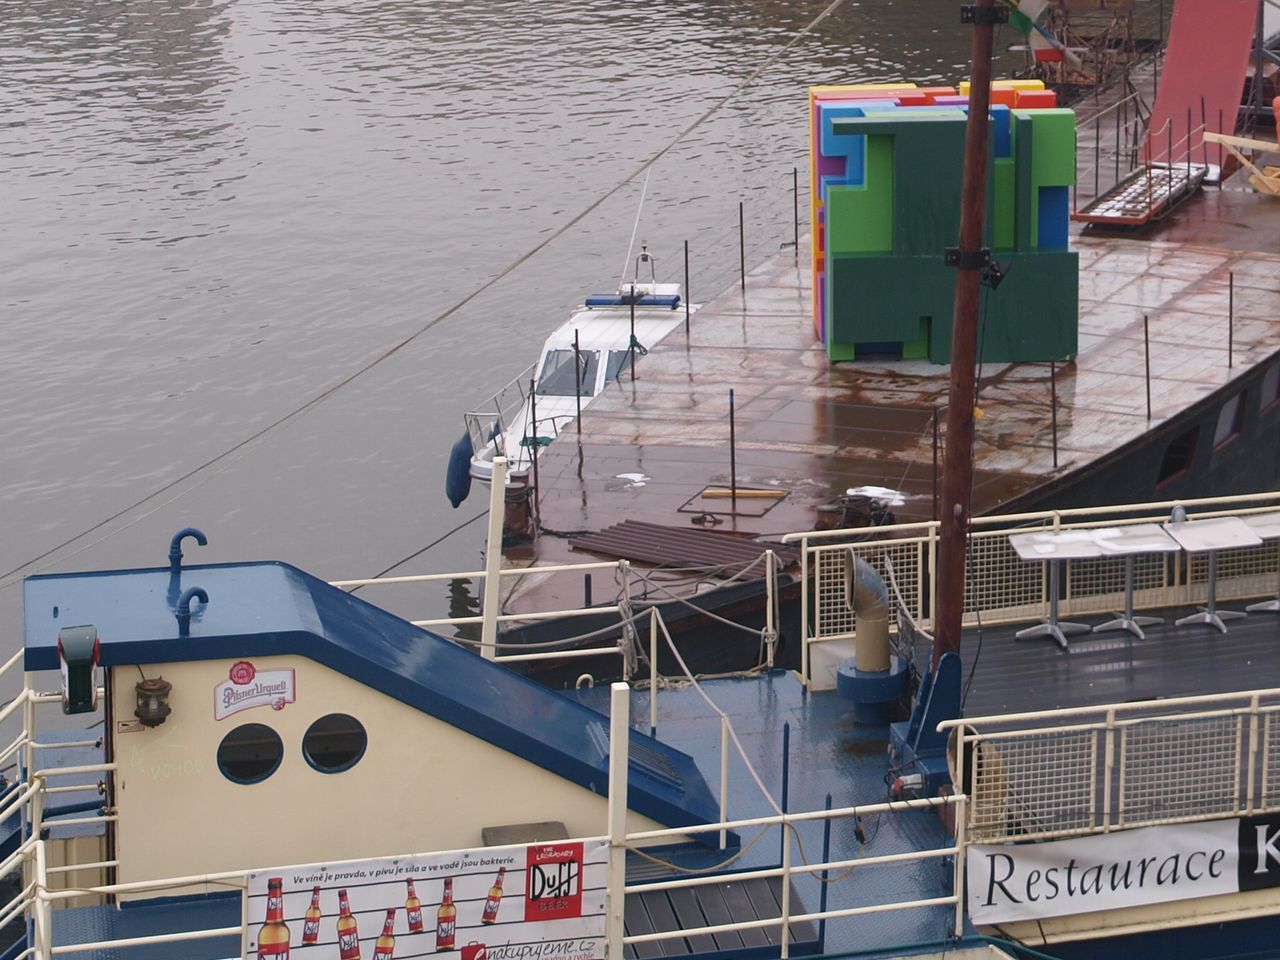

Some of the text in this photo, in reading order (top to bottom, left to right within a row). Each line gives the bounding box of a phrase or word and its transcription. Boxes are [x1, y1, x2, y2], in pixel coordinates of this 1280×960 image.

[223, 681, 287, 709] Pilsner Urquell
[293, 876, 304, 884] Ve
[334, 870, 367, 882] pravda,
[375, 866, 394, 878] pivu
[460, 859, 478, 870] jsou
[529, 859, 579, 901] Duff
[981, 848, 1226, 907] Restaurace
